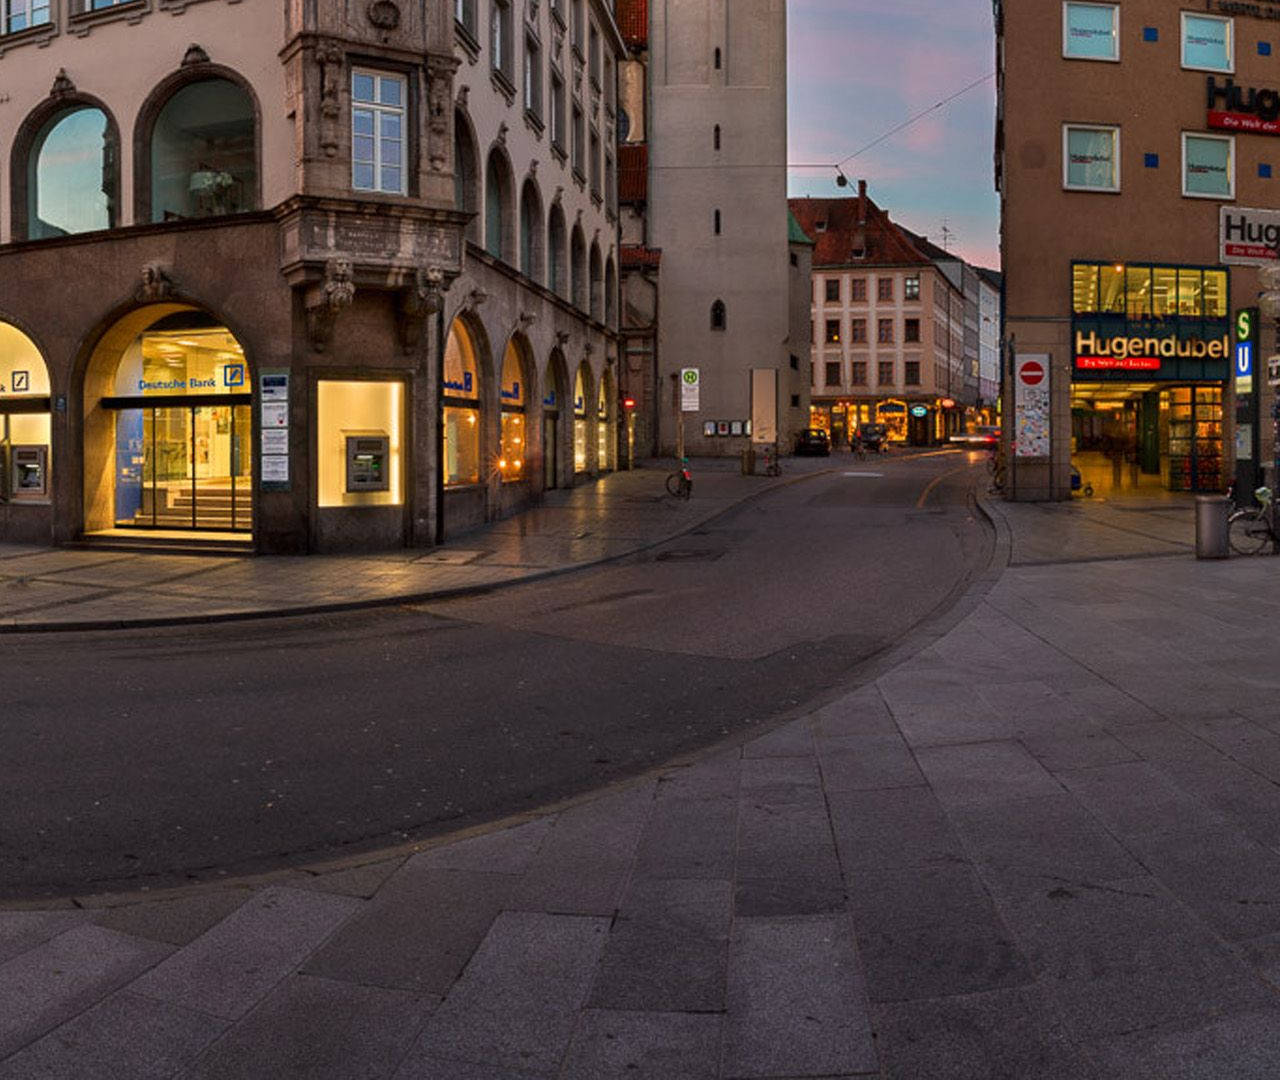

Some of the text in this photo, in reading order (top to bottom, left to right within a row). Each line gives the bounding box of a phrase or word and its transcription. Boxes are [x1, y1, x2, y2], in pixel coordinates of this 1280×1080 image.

[1238, 312, 1249, 339] S
[1076, 330, 1229, 359] Hugendubel
[1239, 347, 1249, 372] U
[138, 377, 216, 390] Deutsche Bank
